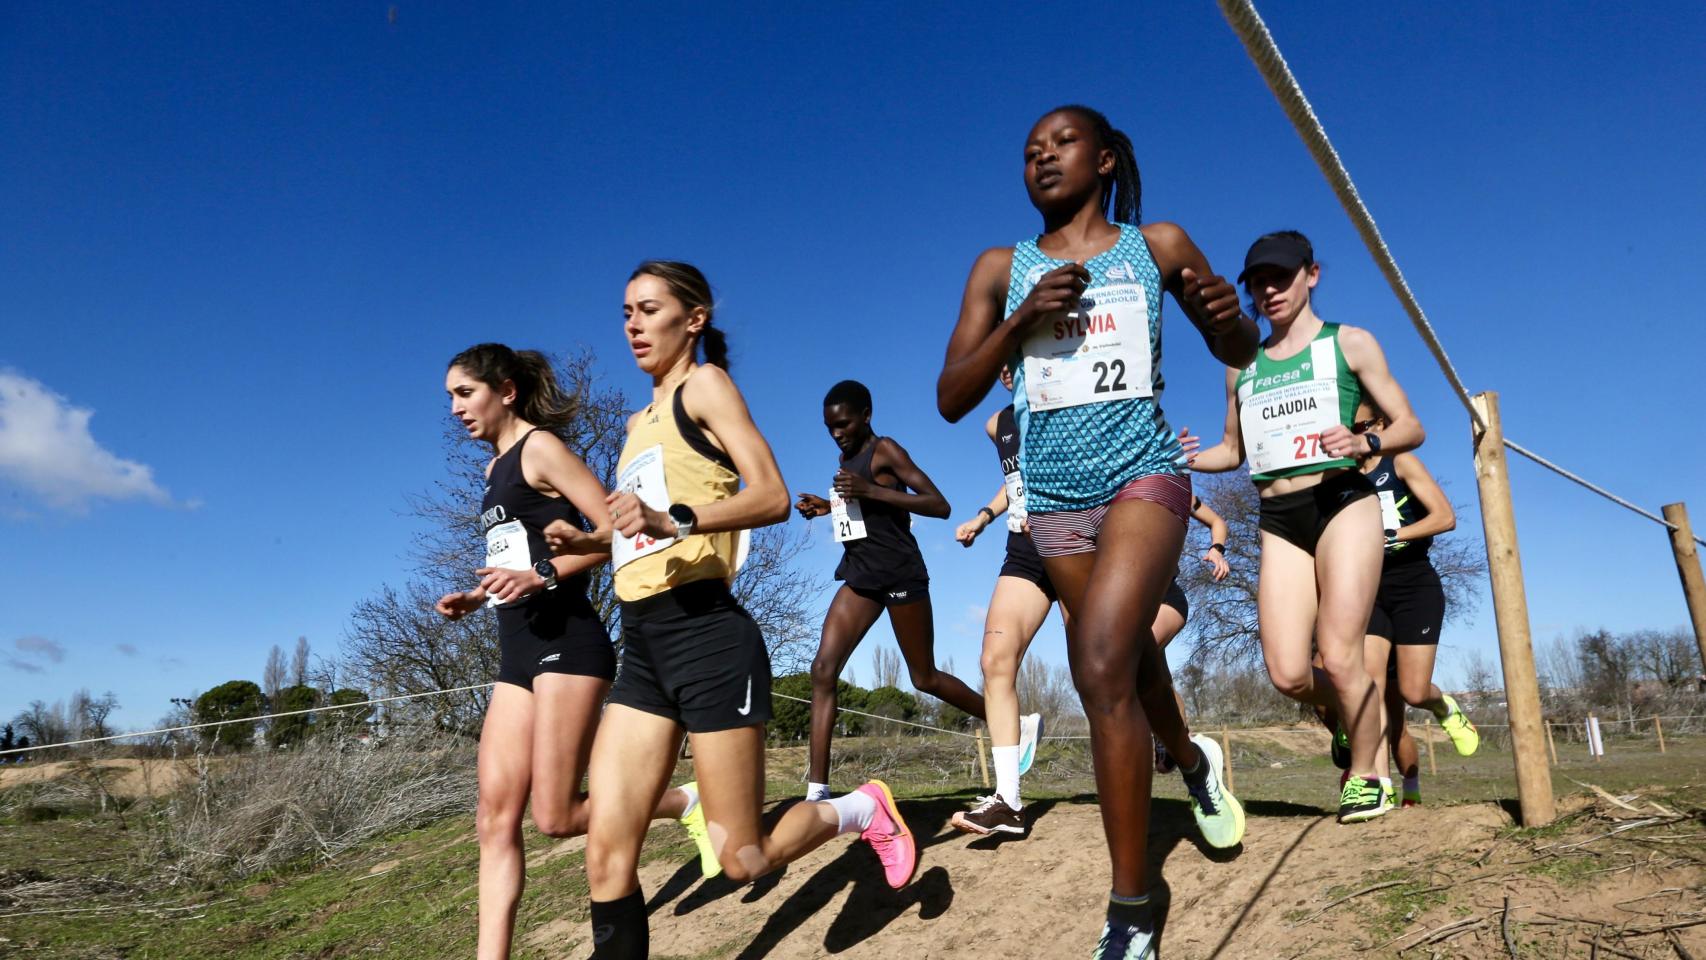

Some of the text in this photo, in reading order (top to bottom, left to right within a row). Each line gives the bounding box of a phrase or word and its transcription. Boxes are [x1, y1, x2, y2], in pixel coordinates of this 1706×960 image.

[1081, 296, 1138, 308] VALLADOLID
[1054, 312, 1116, 341] SYLVIA
[1092, 358, 1127, 394] 22
[1262, 396, 1318, 420] CLAUDIA
[1293, 433, 1320, 460] 27
[1017, 486, 1024, 497] G
[839, 520, 852, 537] 21
